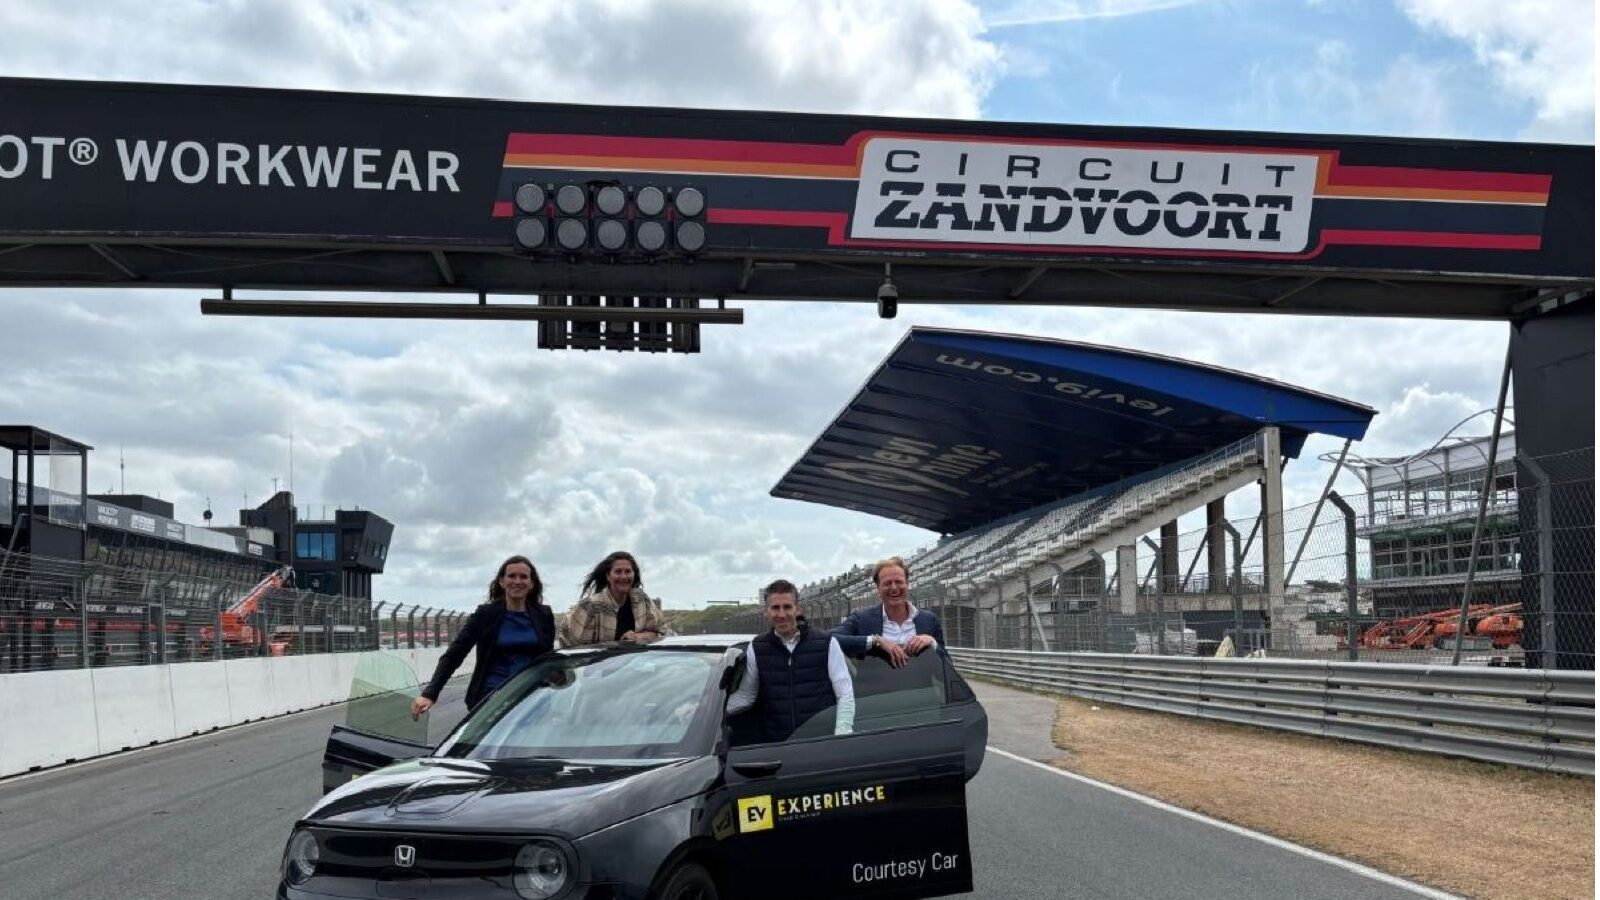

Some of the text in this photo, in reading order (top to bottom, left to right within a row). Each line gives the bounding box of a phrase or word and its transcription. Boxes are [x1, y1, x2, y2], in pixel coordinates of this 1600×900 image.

[116, 138, 461, 192] WORKWEAR
[884, 149, 1296, 188] CIRCUIT
[874, 181, 1294, 242] ZANDVOORT
[935, 354, 1174, 416] levi9.com
[747, 786, 885, 823] EV EXPERIENCE
[852, 852, 959, 883] Courtesy Car
